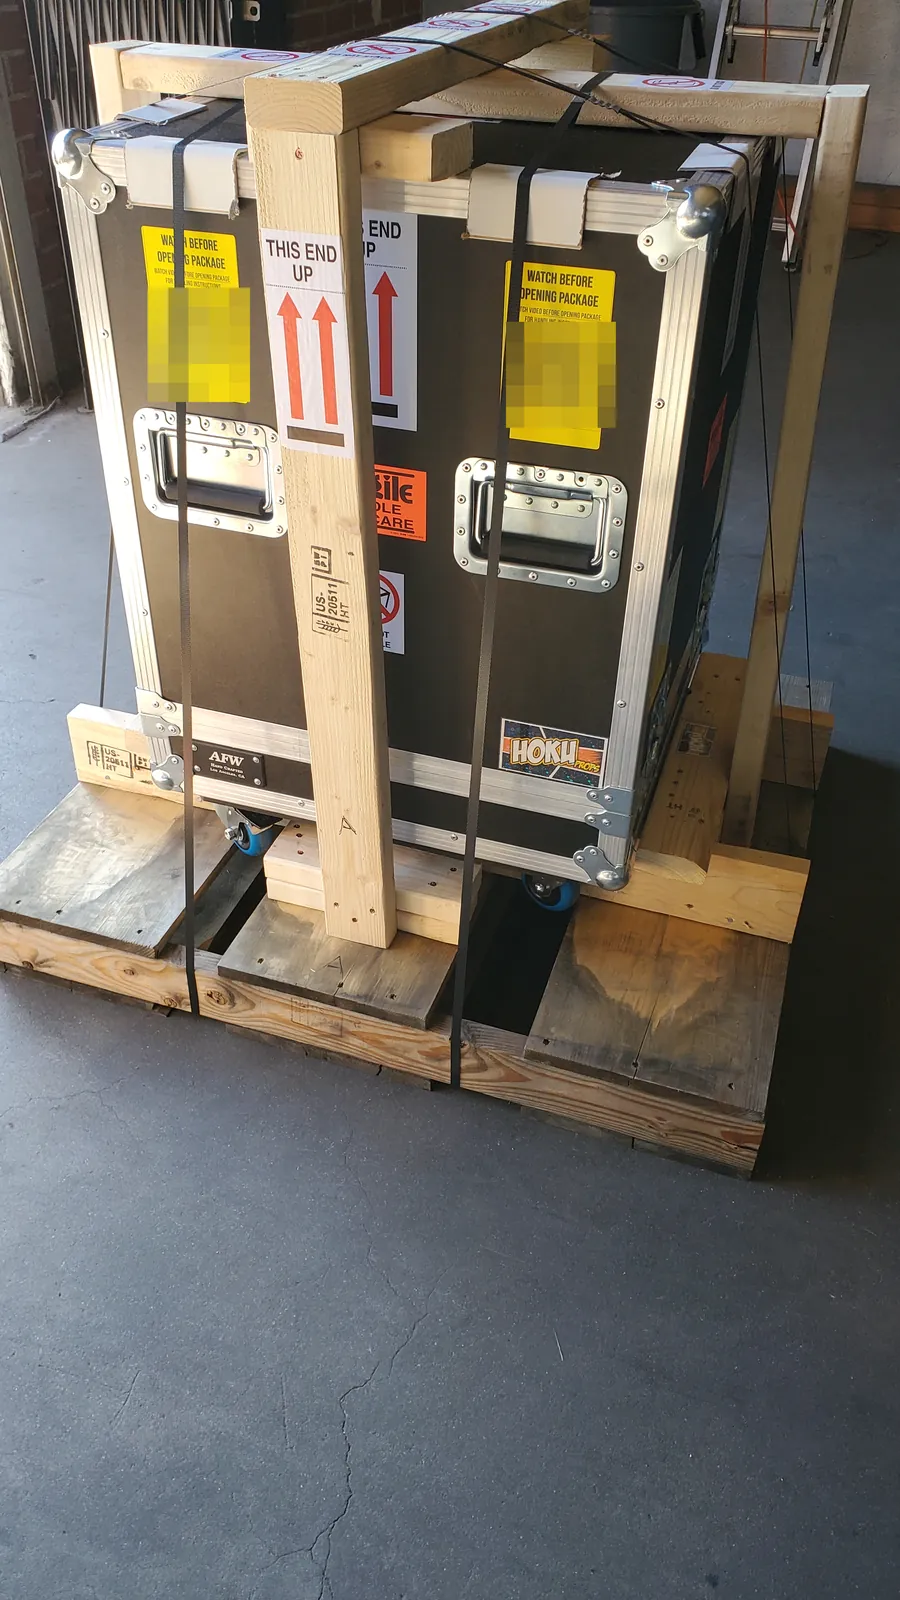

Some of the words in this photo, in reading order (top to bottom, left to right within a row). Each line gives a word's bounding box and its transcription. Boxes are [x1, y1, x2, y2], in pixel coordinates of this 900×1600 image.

[369, 219, 402, 240] END
[189, 237, 218, 252] BEFORE
[265, 239, 300, 260] THIS
[305, 242, 337, 263] END
[191, 254, 226, 270] PACKAGE
[292, 264, 313, 283] UP
[527, 269, 558, 284] WATCH
[559, 273, 594, 288] BEFORE
[520, 287, 557, 303] OPENING
[558, 291, 599, 308] PACKAGE
[529, 307, 542, 315] VIDEO
[542, 308, 560, 317] BEFORE
[560, 309, 580, 319] OPENING
[580, 311, 602, 321] PACKAGE
[315, 591, 326, 612] US-
[328, 582, 338, 616] 20511
[340, 602, 350, 619] HT
[208, 751, 245, 767] AFW
[510, 737, 579, 766] HOKU
[573, 760, 601, 773] PROPS
